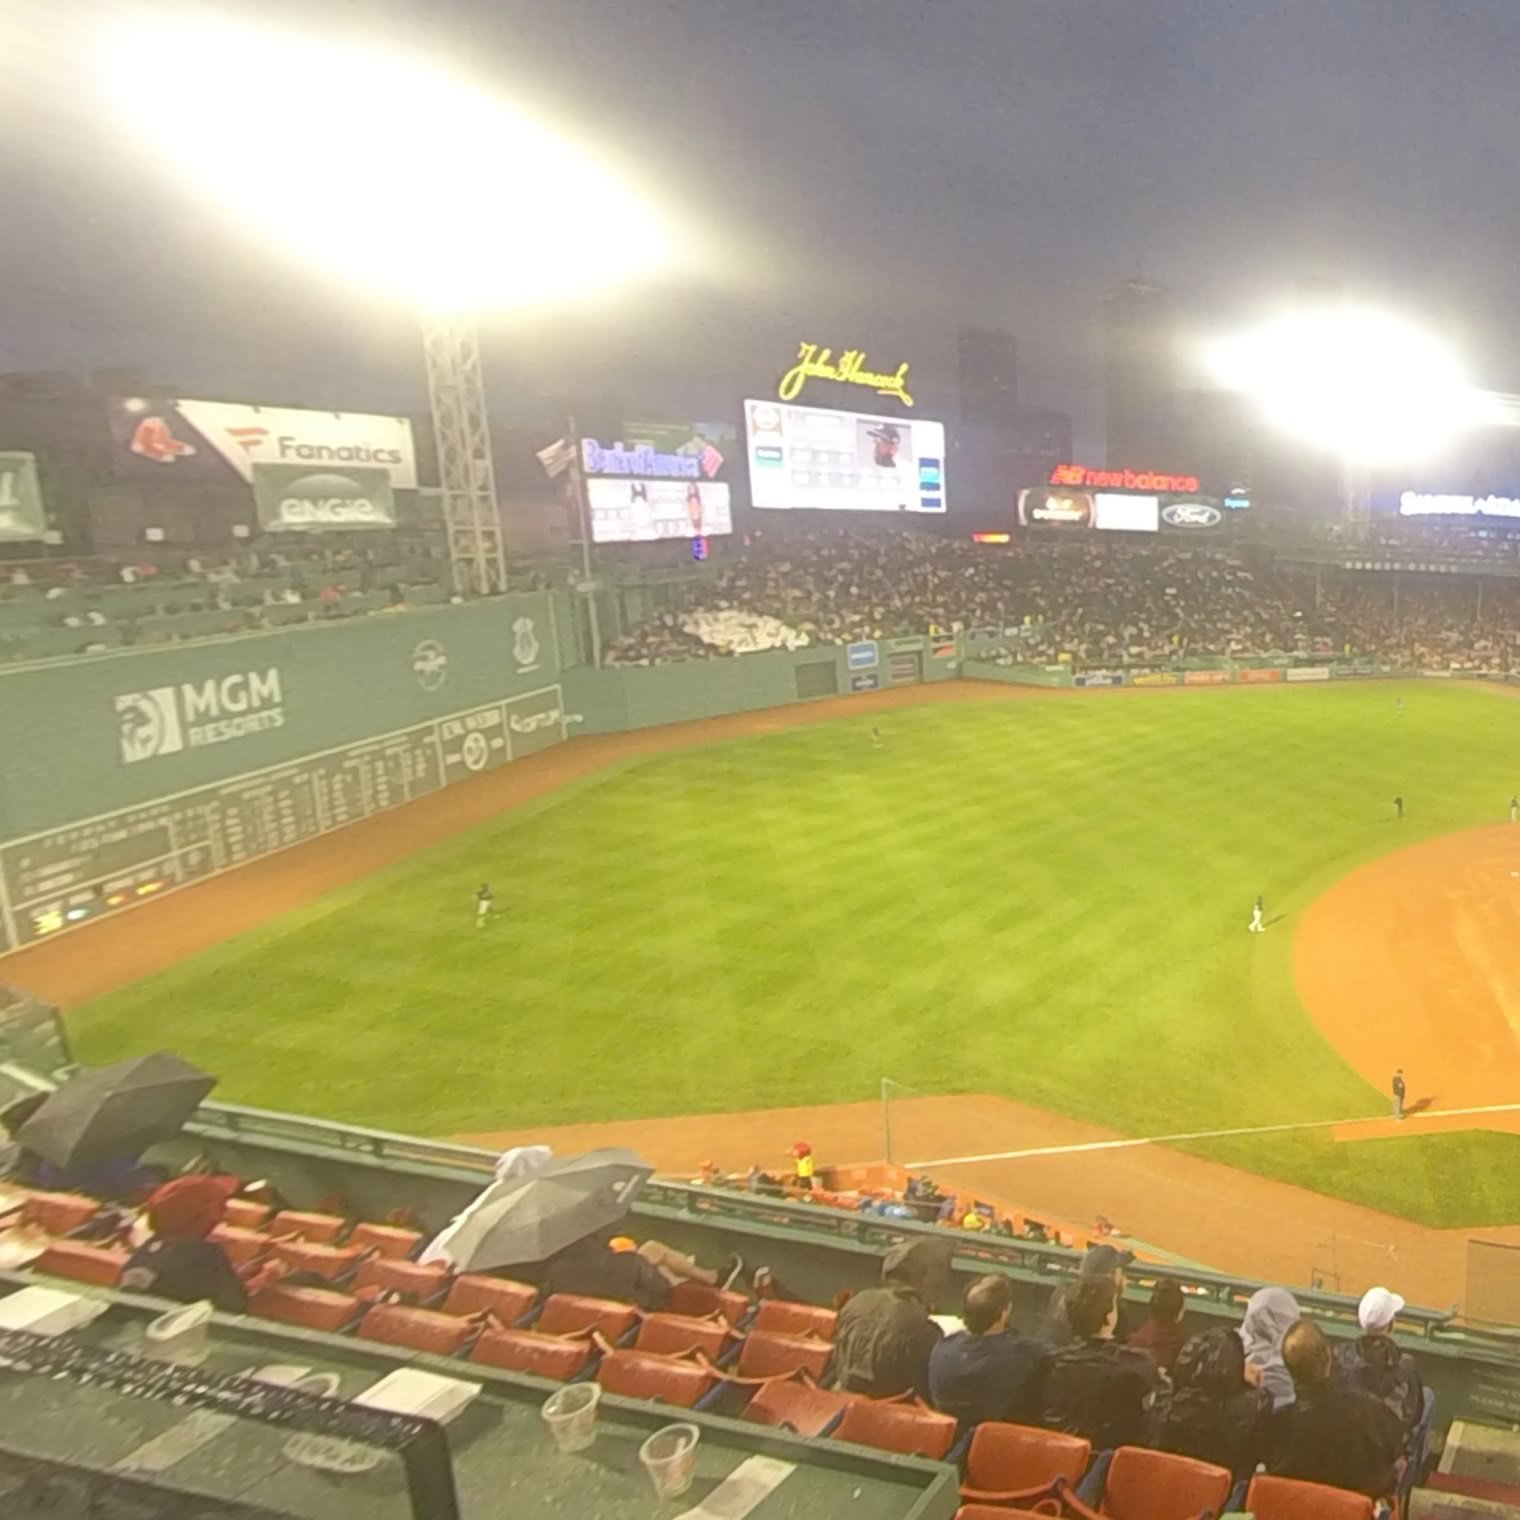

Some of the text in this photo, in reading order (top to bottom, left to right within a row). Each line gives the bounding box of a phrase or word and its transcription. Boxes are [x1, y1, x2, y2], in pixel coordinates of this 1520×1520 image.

[276, 437, 403, 465] Fanatics
[1172, 506, 1212, 525] Ford
[181, 667, 283, 722] MGM
[188, 706, 284, 748] RESORTS
